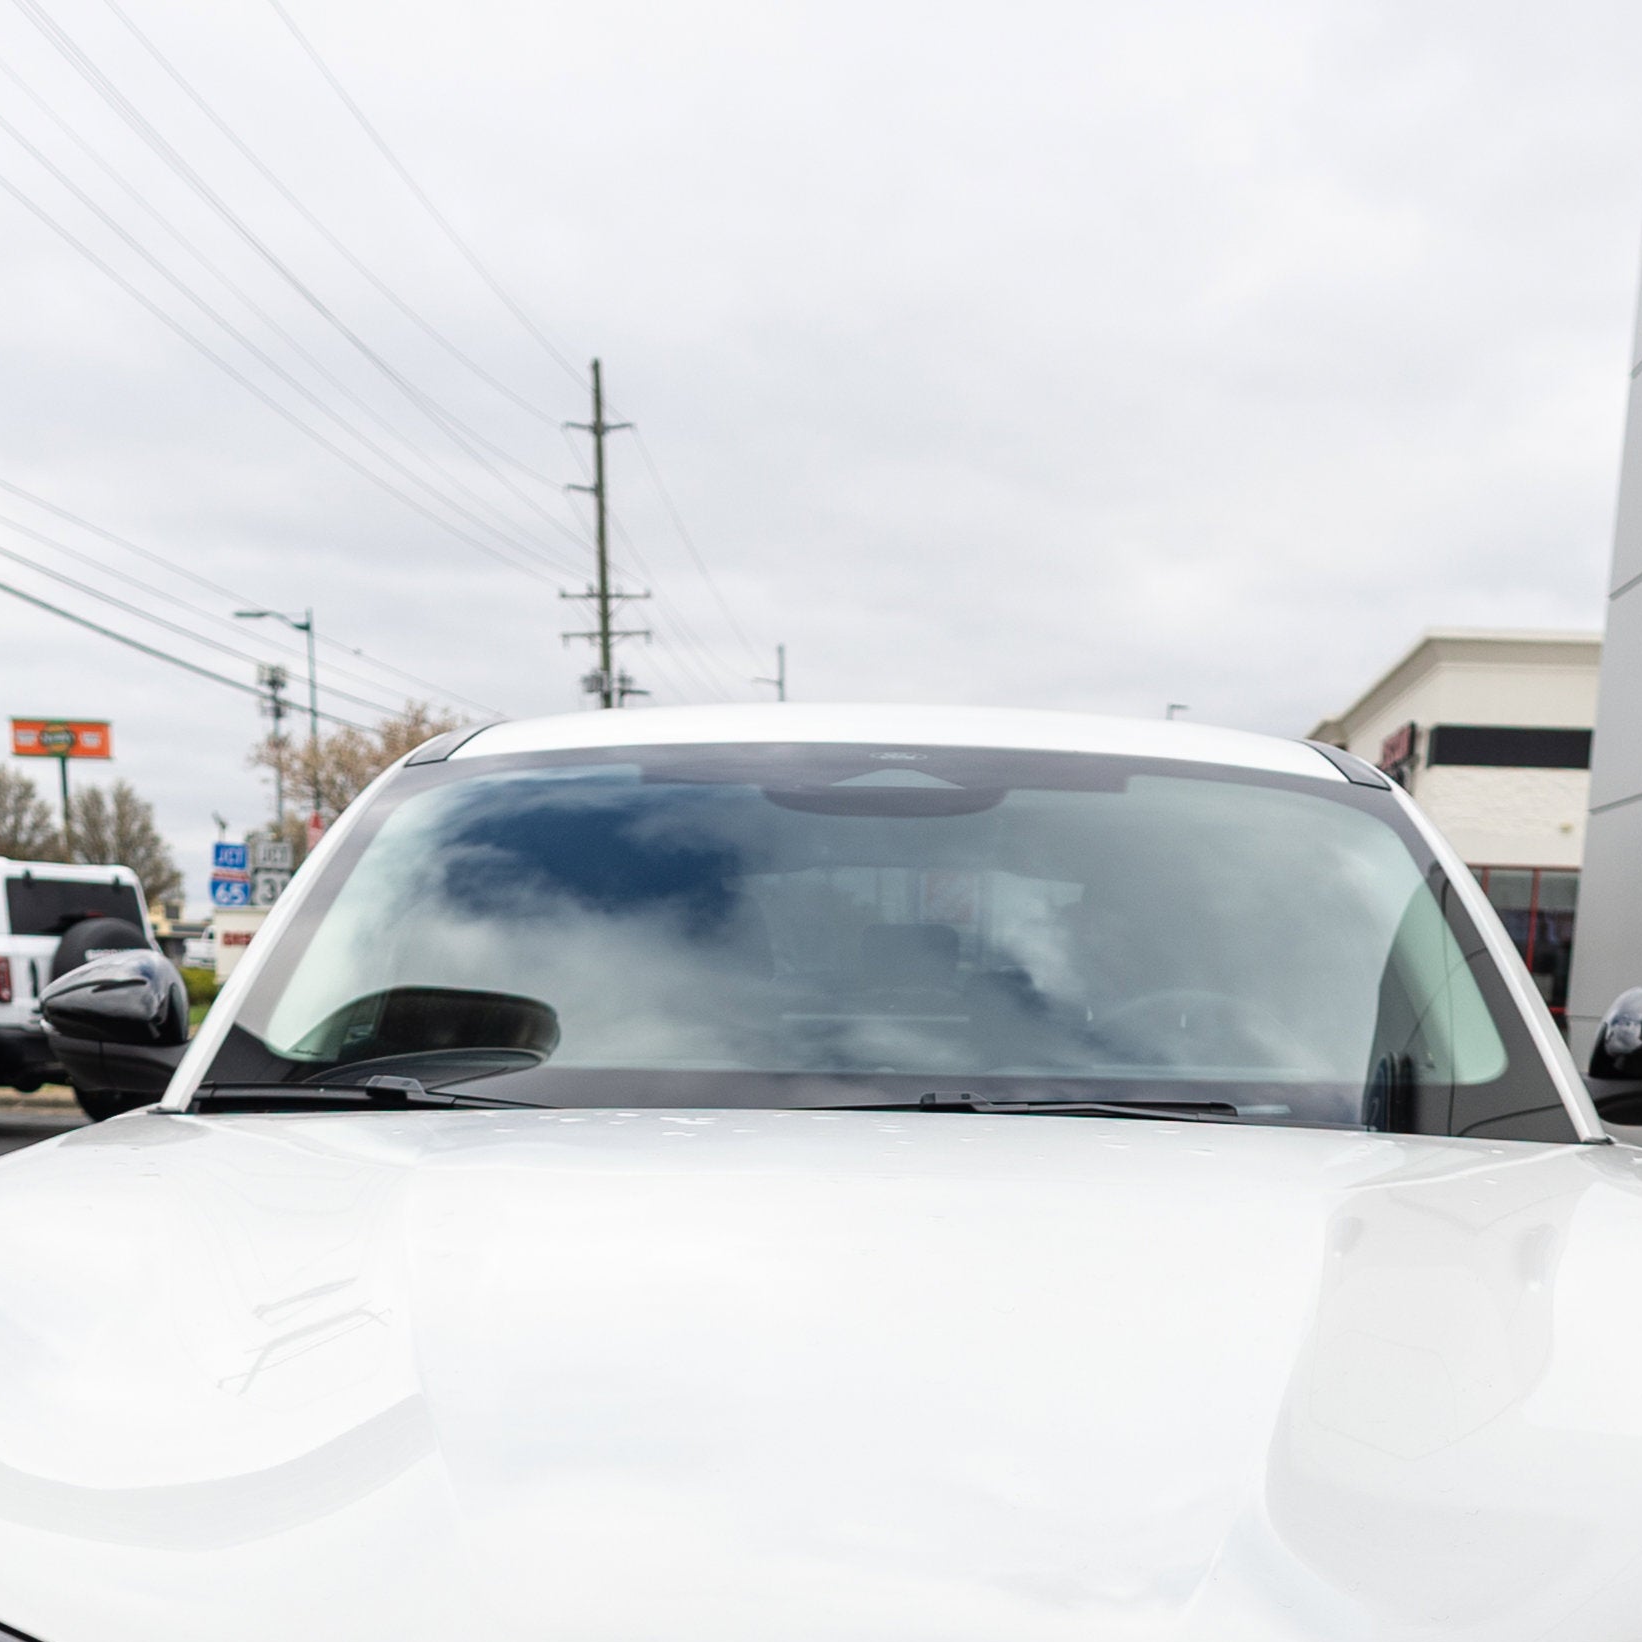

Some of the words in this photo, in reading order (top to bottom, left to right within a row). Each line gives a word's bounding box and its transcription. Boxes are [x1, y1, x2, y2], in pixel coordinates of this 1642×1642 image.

[219, 847, 244, 864] JCT
[261, 846, 288, 863] JCT
[215, 882, 246, 904] 65
